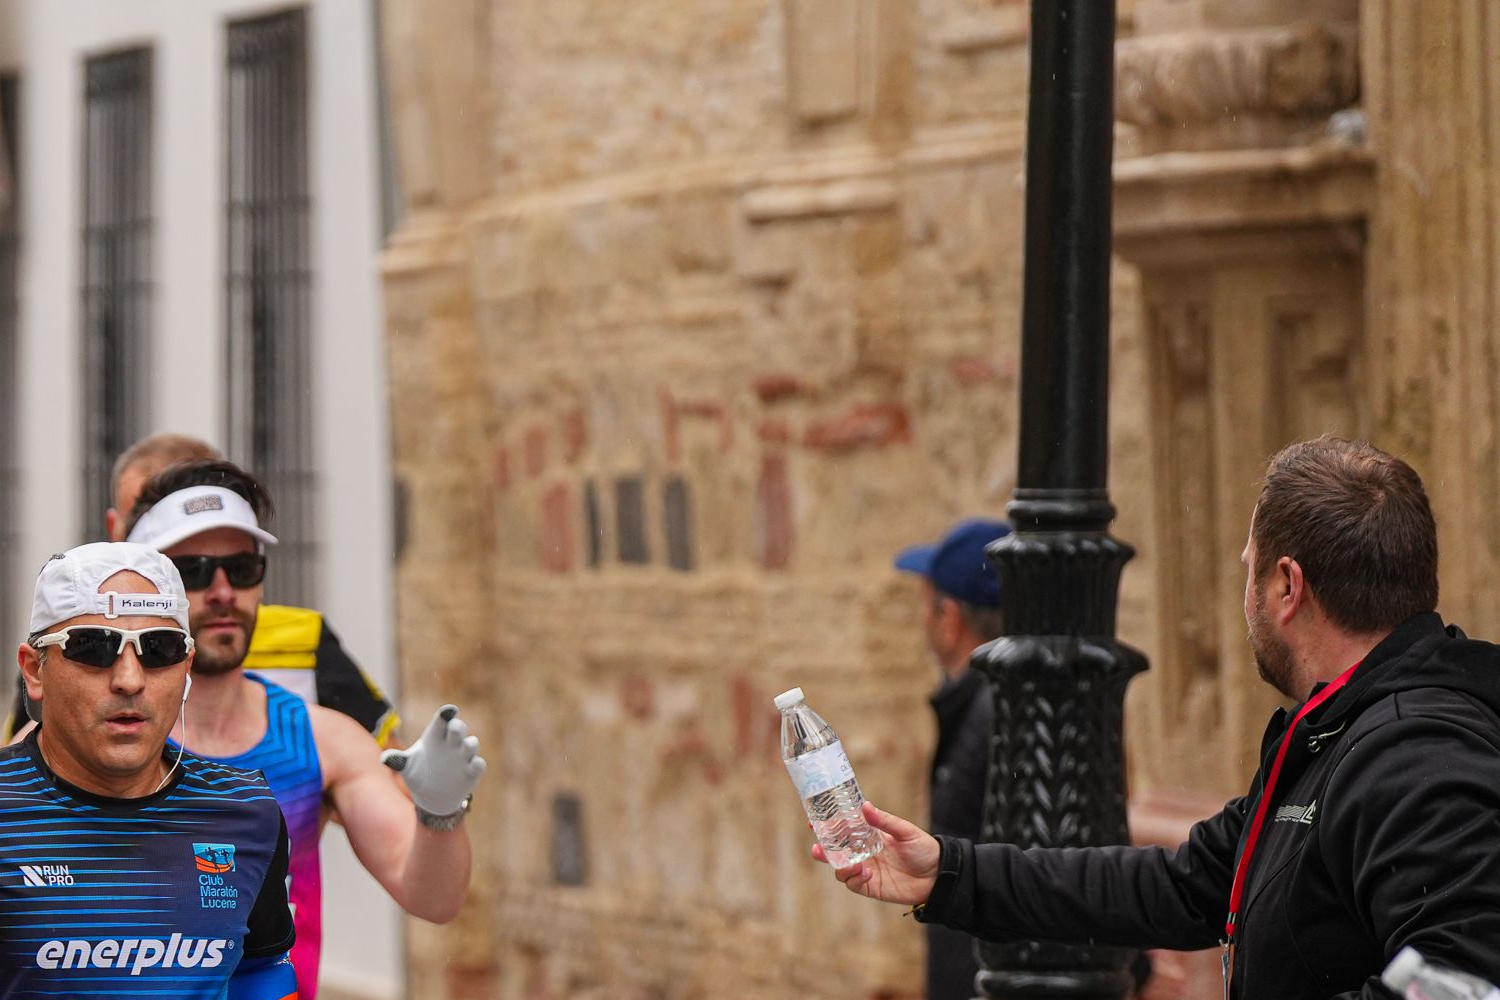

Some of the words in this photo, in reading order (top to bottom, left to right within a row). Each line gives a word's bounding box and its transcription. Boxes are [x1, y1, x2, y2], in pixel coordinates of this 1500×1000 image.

[122, 599, 172, 610] Kalenji
[43, 865, 69, 876] RUN
[48, 875, 75, 886] PRO
[199, 874, 224, 886] Club
[201, 886, 238, 898] Maratón
[201, 897, 237, 909] Lucena
[36, 933, 227, 976] enerplus
